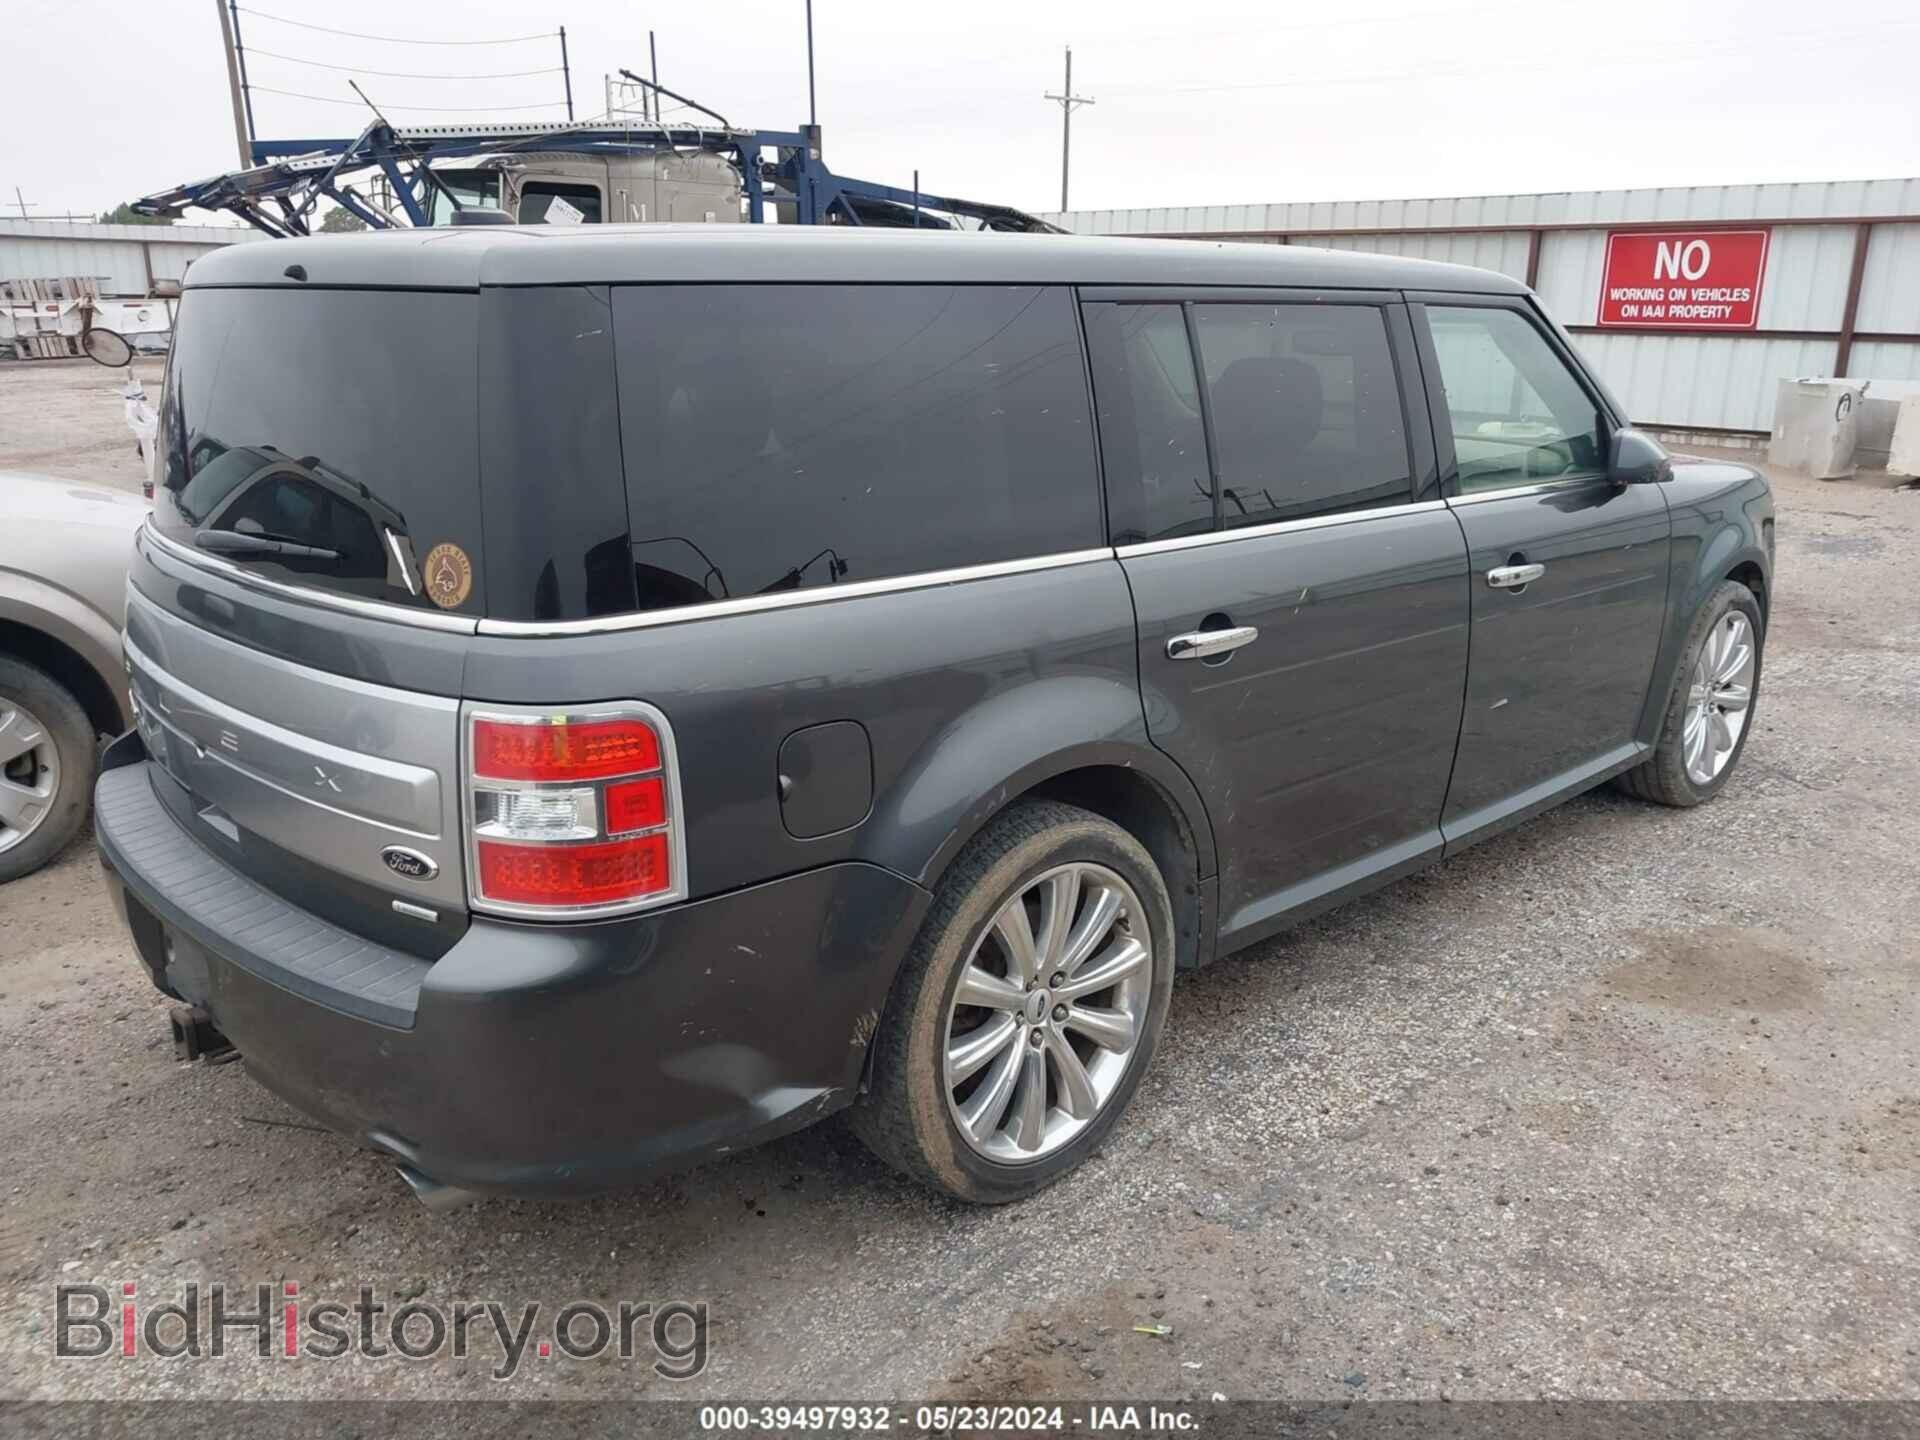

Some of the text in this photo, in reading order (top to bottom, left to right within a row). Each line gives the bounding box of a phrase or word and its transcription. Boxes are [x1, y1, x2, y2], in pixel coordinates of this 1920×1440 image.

[1653, 239, 1711, 280] NO
[1610, 288, 1751, 302] WORKING ON VEHICLES
[1621, 305, 1733, 319] ON IAAI PROPERTY
[389, 852, 421, 875] Ford
